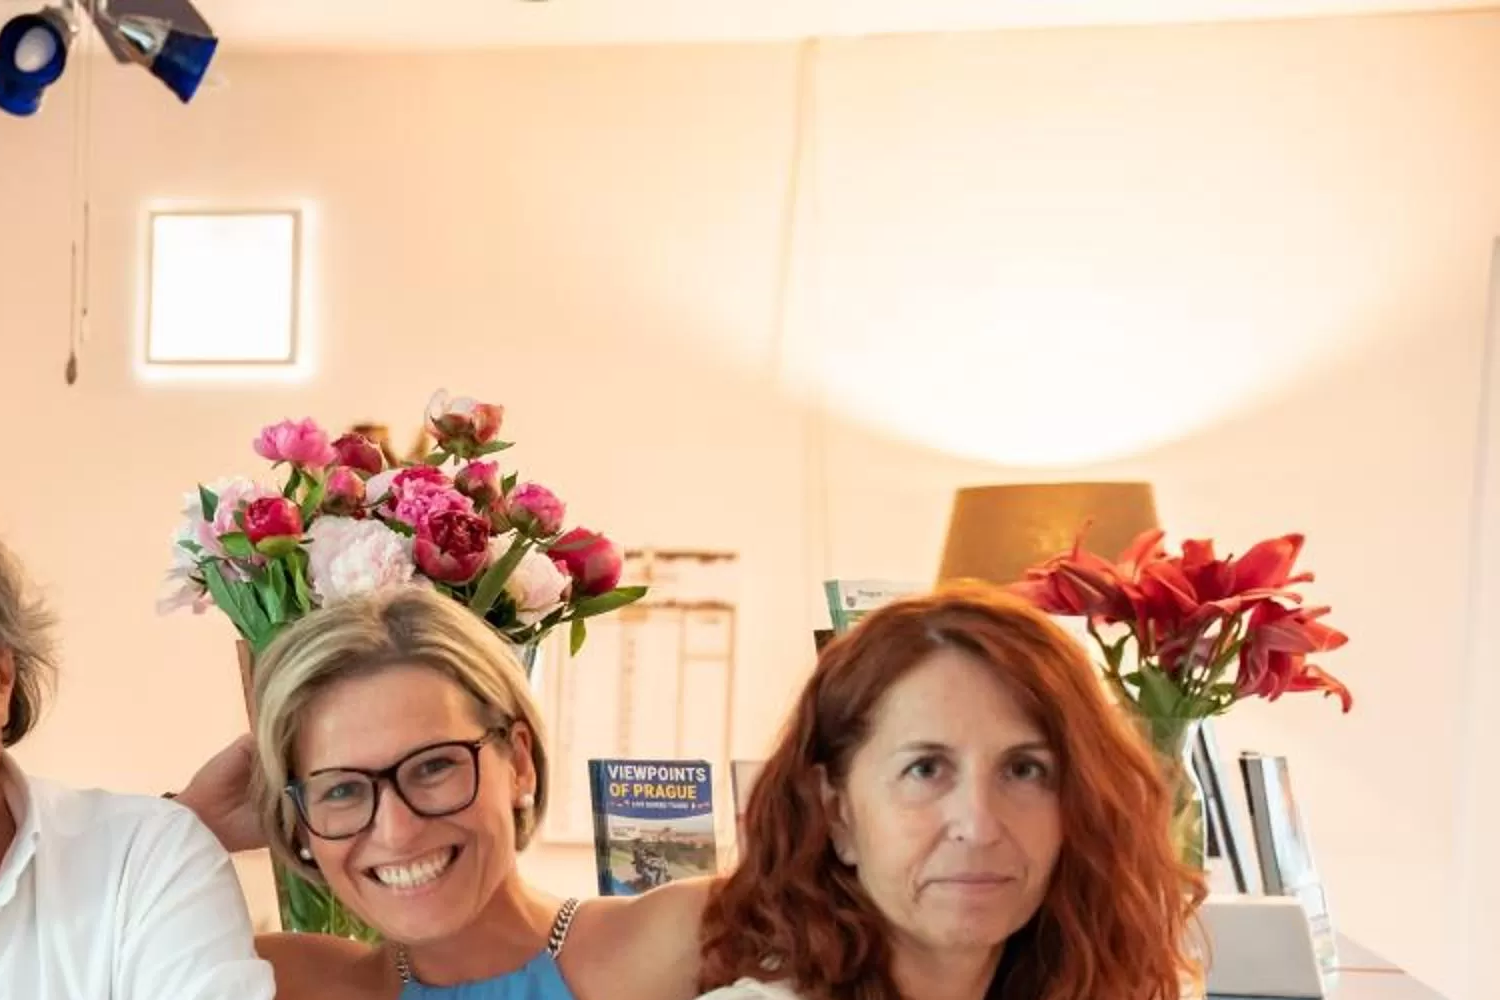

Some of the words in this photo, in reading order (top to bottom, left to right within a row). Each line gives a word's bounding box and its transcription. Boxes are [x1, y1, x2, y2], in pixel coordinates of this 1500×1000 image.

[607, 765, 706, 782] VIEWPOINTS
[609, 783, 629, 797] OF
[633, 785, 697, 799] PRAGUE
